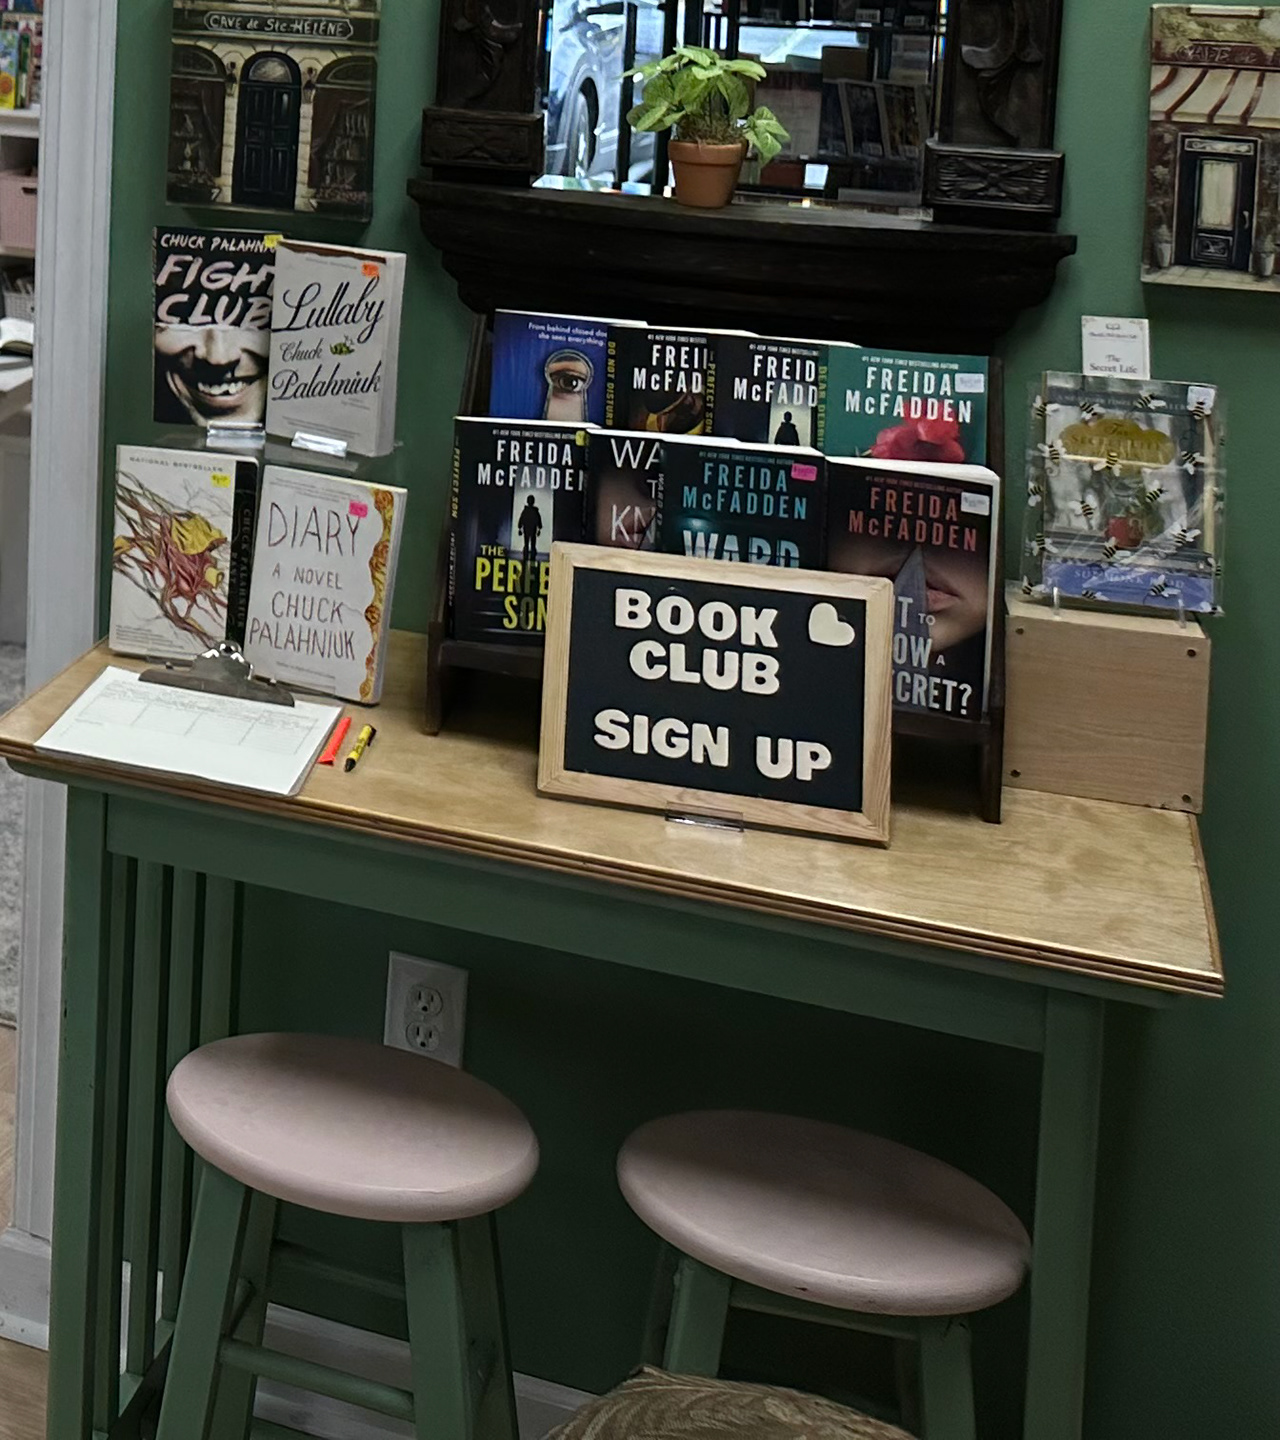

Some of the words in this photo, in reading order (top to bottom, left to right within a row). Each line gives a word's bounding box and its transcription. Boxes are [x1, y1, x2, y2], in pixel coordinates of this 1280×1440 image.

[209, 15, 241, 28] CAVE
[160, 233, 206, 250] CHUCK
[211, 236, 276, 254] PALAHN
[157, 293, 272, 329] CLUB
[272, 276, 384, 344] Lullaby
[528, 321, 545, 331] From
[547, 323, 571, 334] behind
[572, 325, 595, 337] closed
[538, 332, 550, 340] she
[551, 334, 566, 343] sees
[280, 337, 324, 362] Chuck
[608, 341, 617, 356] DO
[272, 360, 382, 401] Palahniuk
[607, 358, 617, 380] NOT
[753, 354, 817, 382] FREID
[866, 366, 952, 396] FREIDA
[1090, 363, 1117, 373] Secret
[1119, 364, 1138, 374] Life
[705, 363, 716, 408] PERFECT
[733, 377, 817, 408] McFADD
[606, 382, 615, 426] DISTURB
[845, 390, 972, 423] McFADDEN
[705, 410, 714, 434] SON
[496, 440, 573, 466] FREIDA
[703, 462, 788, 492] FREIDA
[682, 484, 807, 520] McFADDEN
[870, 487, 957, 522] FREIDA
[268, 502, 360, 557] DIARY
[848, 510, 978, 552] McFADDEN
[481, 545, 505, 557] THE
[683, 529, 800, 567] WARD
[272, 563, 281, 580] A
[293, 566, 343, 590] NOVEL
[271, 590, 344, 625] CHUCK
[614, 588, 779, 649] BOOK
[919, 612, 935, 626] TO
[248, 618, 355, 661] PALAHNIUK
[628, 640, 781, 695] CLUB
[593, 709, 730, 769] SIGN
[756, 737, 832, 782] UP
